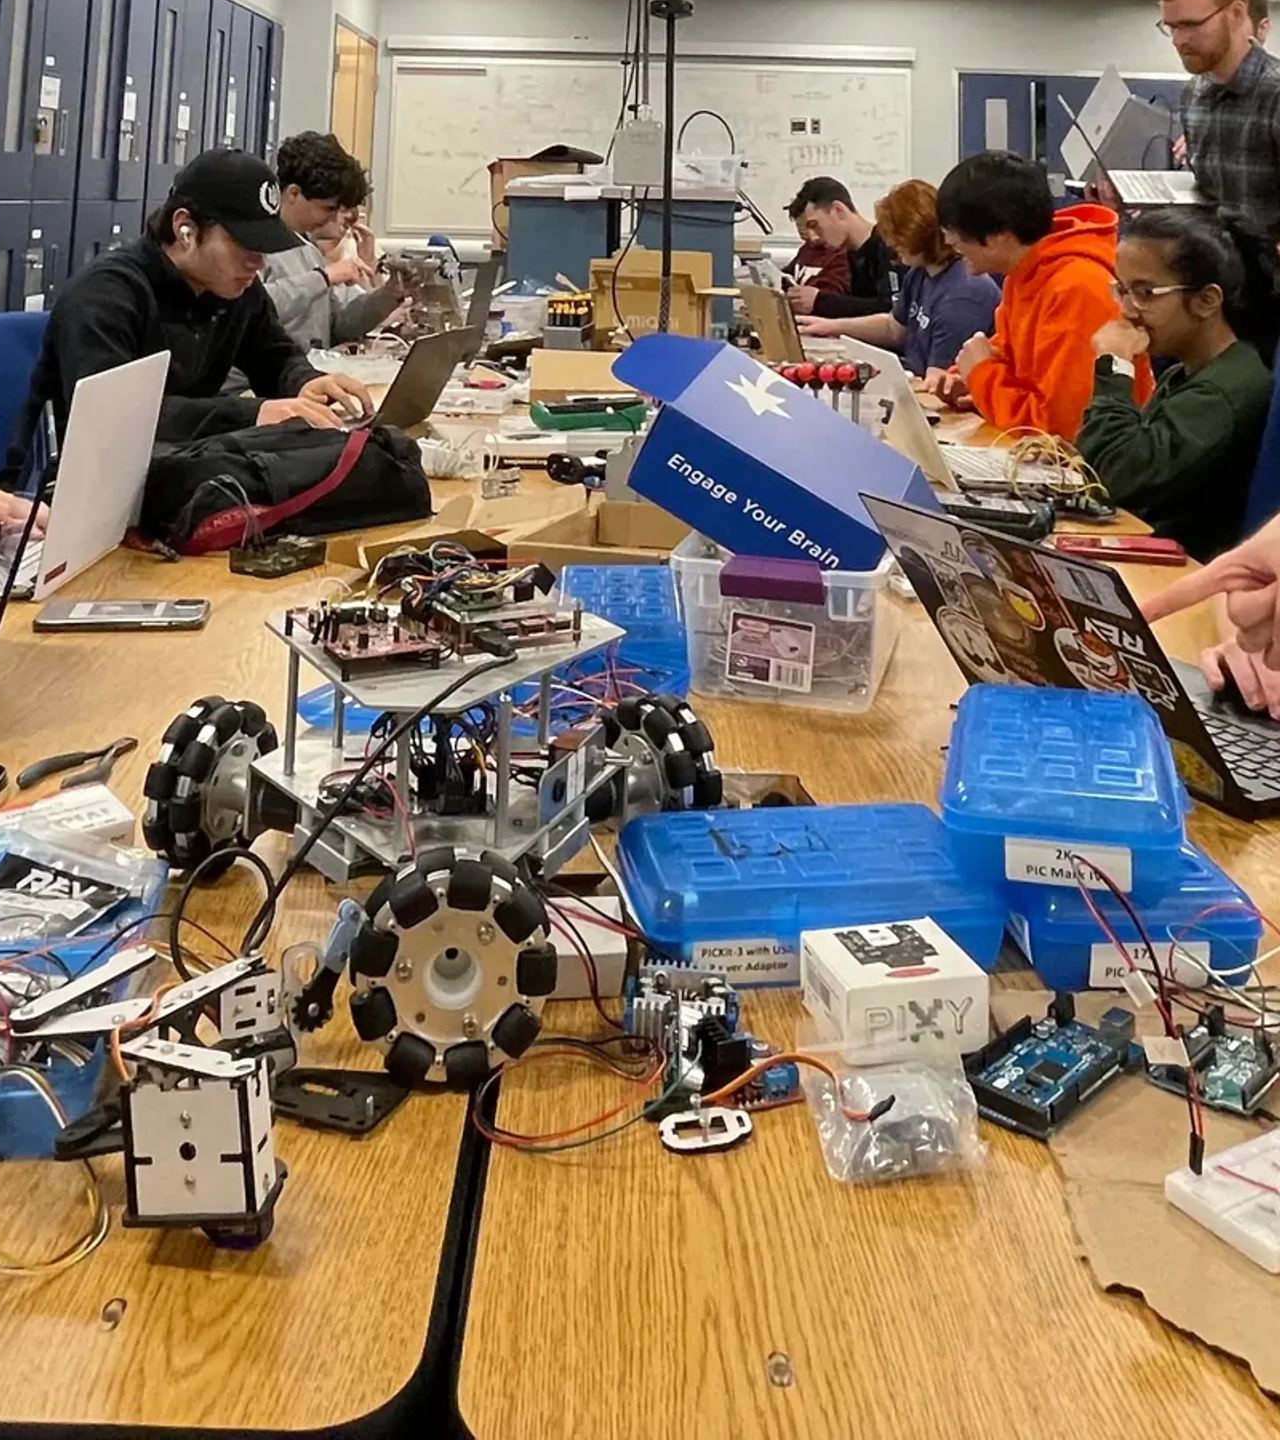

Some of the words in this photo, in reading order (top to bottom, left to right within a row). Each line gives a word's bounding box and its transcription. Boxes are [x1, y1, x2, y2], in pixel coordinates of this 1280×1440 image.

[667, 453, 738, 505] Engage
[742, 498, 787, 534] Your
[787, 529, 841, 570] Brain
[16, 868, 99, 900] REV
[1025, 864, 1048, 877] PIC
[1105, 966, 1126, 978] PIC
[864, 996, 975, 1044] PIXY
